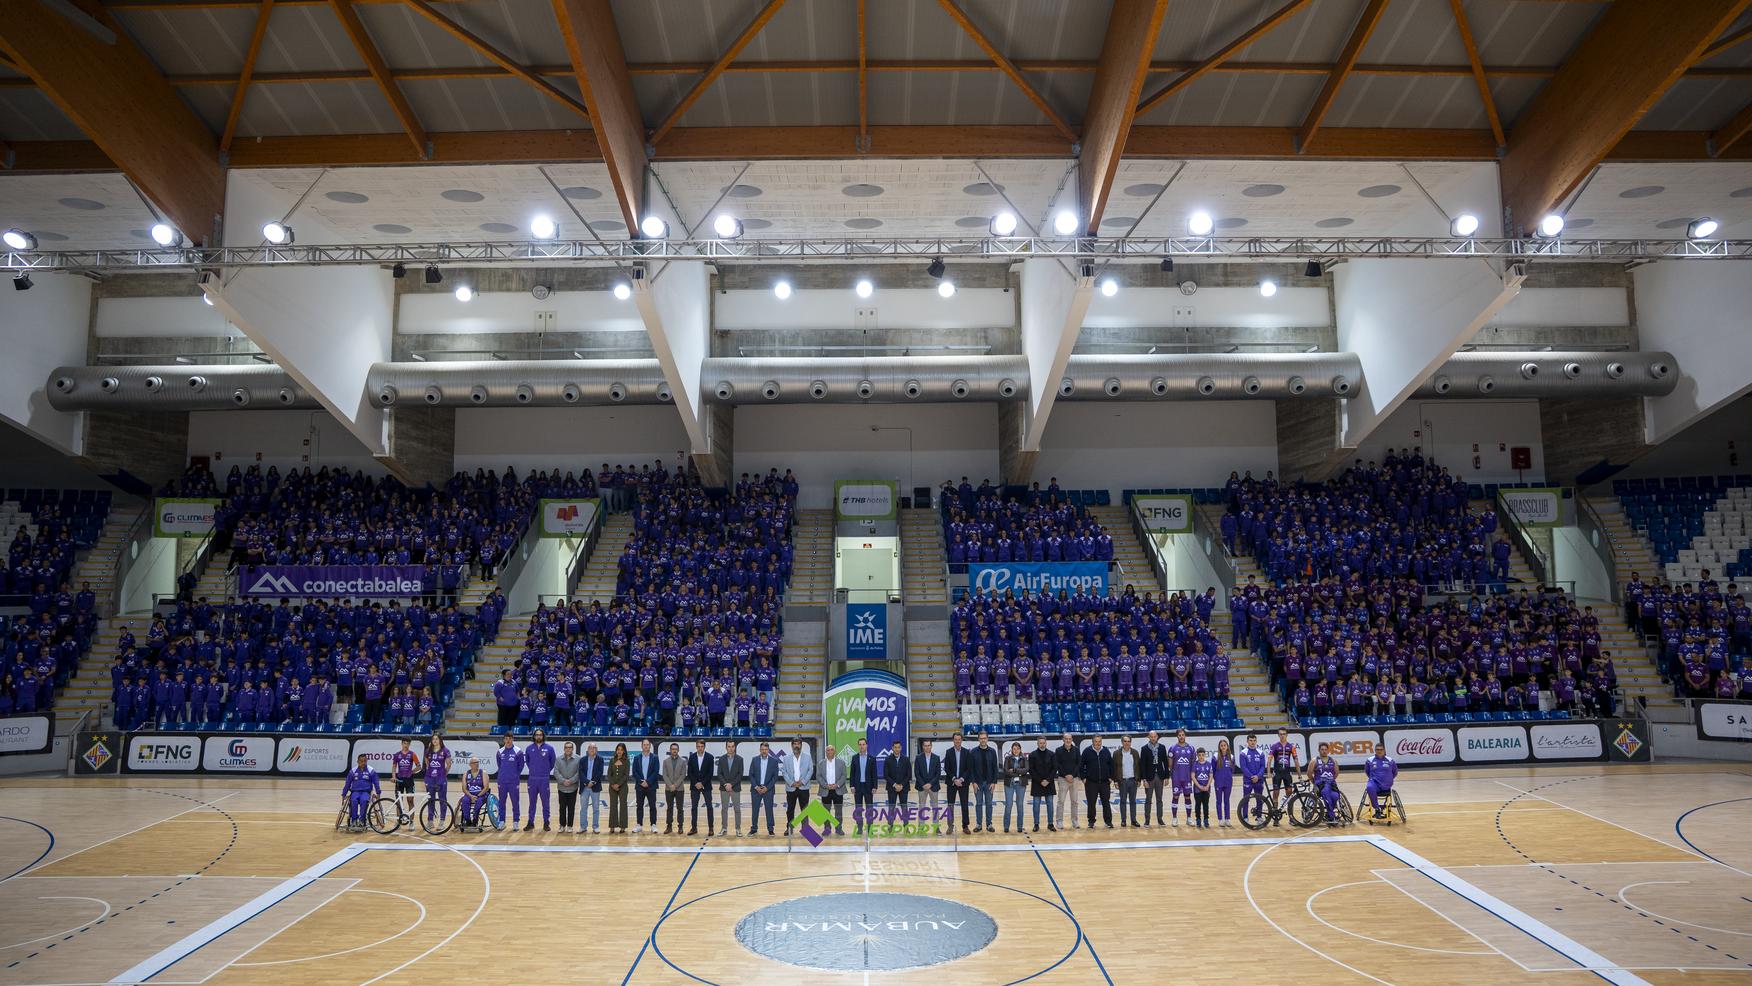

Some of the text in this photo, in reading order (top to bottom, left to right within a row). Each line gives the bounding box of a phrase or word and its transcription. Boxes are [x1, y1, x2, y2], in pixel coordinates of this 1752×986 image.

[1153, 507, 1182, 519] FNG
[303, 576, 423, 593] conectabalea
[849, 628, 884, 644] IME
[835, 696, 897, 715] ¡VAMOS
[835, 715, 898, 734] PALMA!
[153, 744, 192, 760] FNG
[1396, 737, 1444, 756] Coca-Cola
[219, 758, 257, 766] CLIMAES
[852, 806, 954, 822] CONNECTA
[852, 823, 942, 838] L'ESPORT
[764, 920, 967, 932] AUBAMAR
